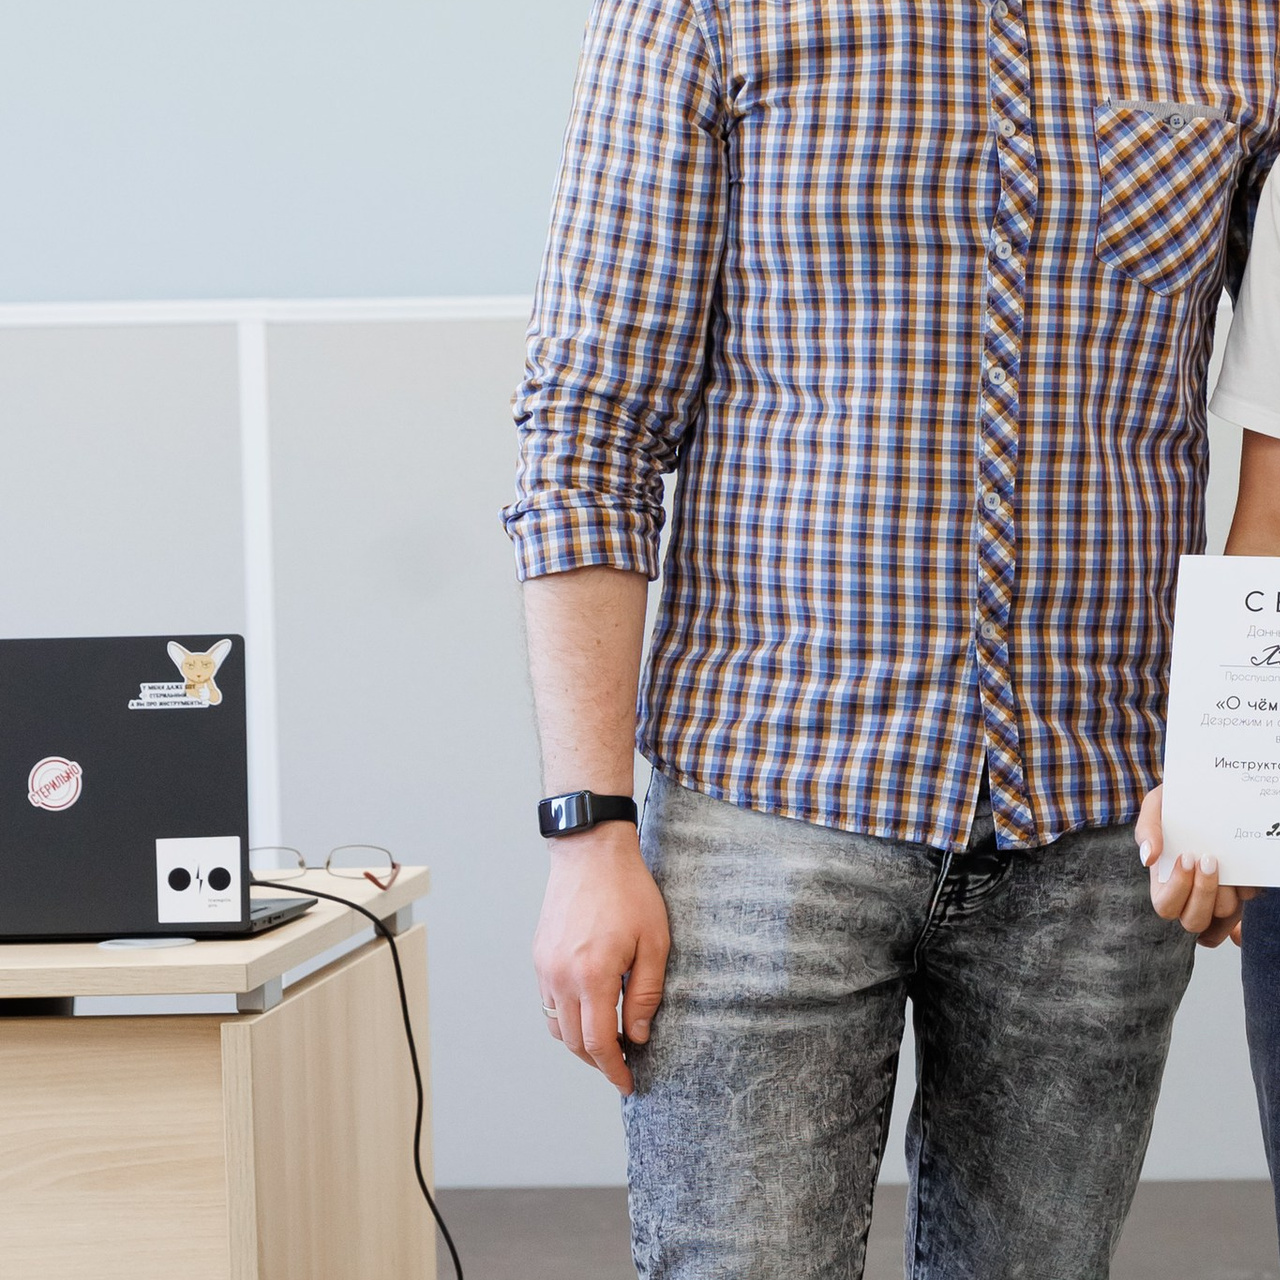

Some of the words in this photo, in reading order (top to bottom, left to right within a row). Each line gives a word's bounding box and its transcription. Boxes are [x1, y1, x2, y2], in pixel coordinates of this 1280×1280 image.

[1216, 695, 1241, 710] «О
[1248, 698, 1278, 712] чём
[1200, 713, 1262, 728] Дезрежим
[1266, 718, 1273, 726] и
[1275, 735, 1280, 743] в
[29, 763, 82, 806] СТЕРИЛЬНО
